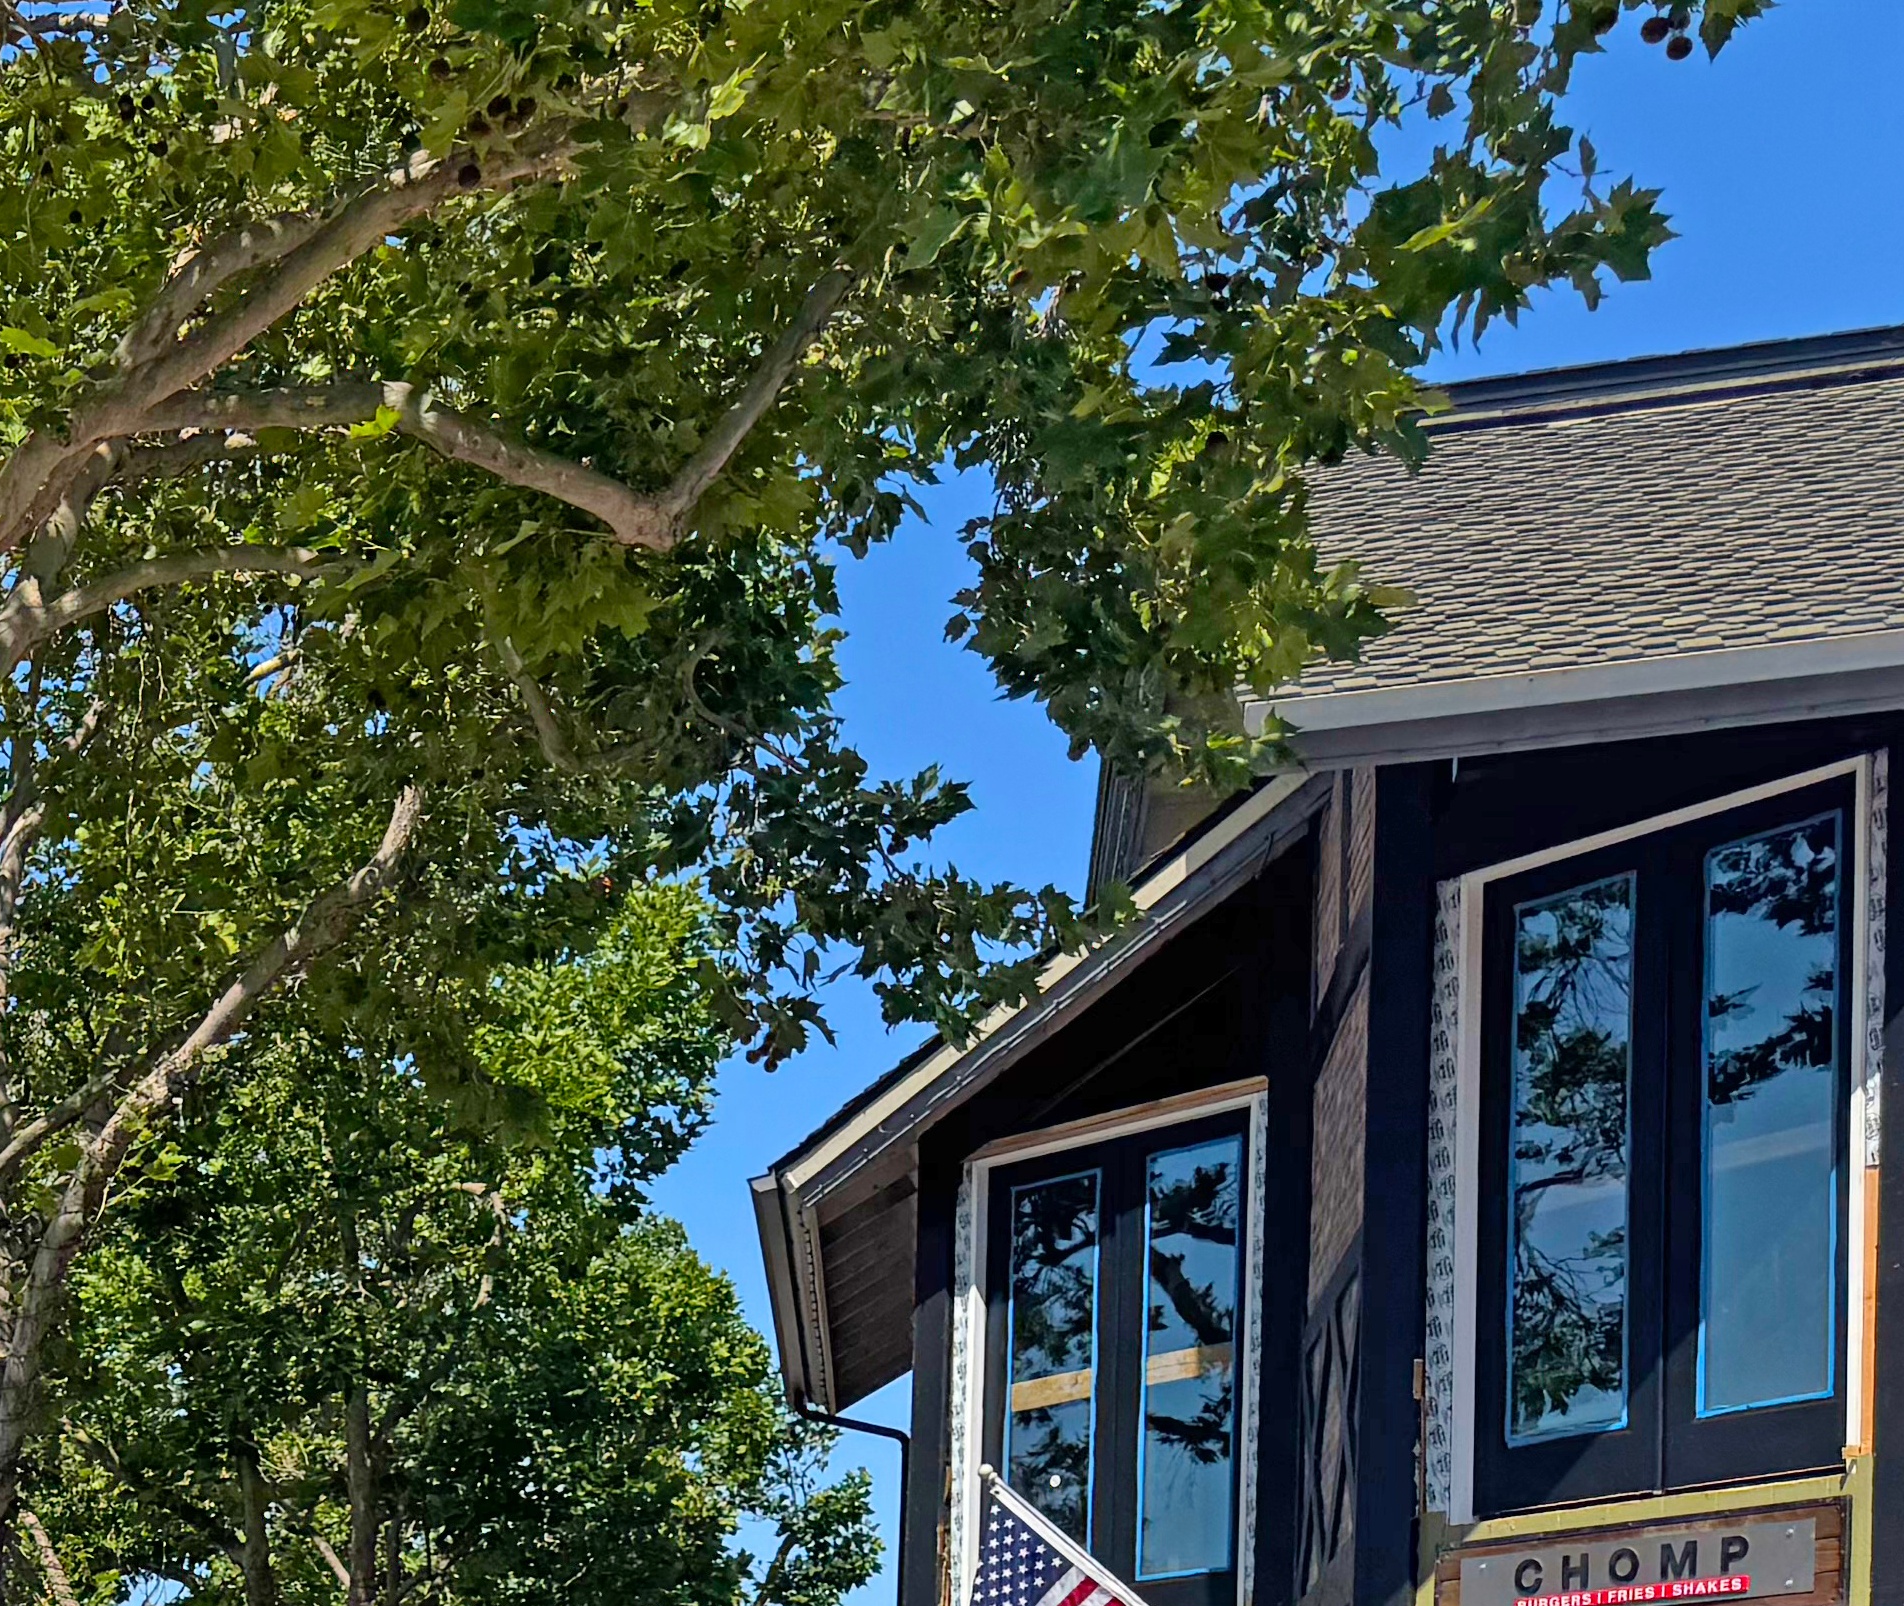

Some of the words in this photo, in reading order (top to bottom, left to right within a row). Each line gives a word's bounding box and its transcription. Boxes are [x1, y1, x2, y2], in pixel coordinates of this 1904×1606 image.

[1514, 1535, 1750, 1595] CHOMP
[1607, 1586, 1655, 1604] FRIES
[1672, 1577, 1742, 1596] SHAKES
